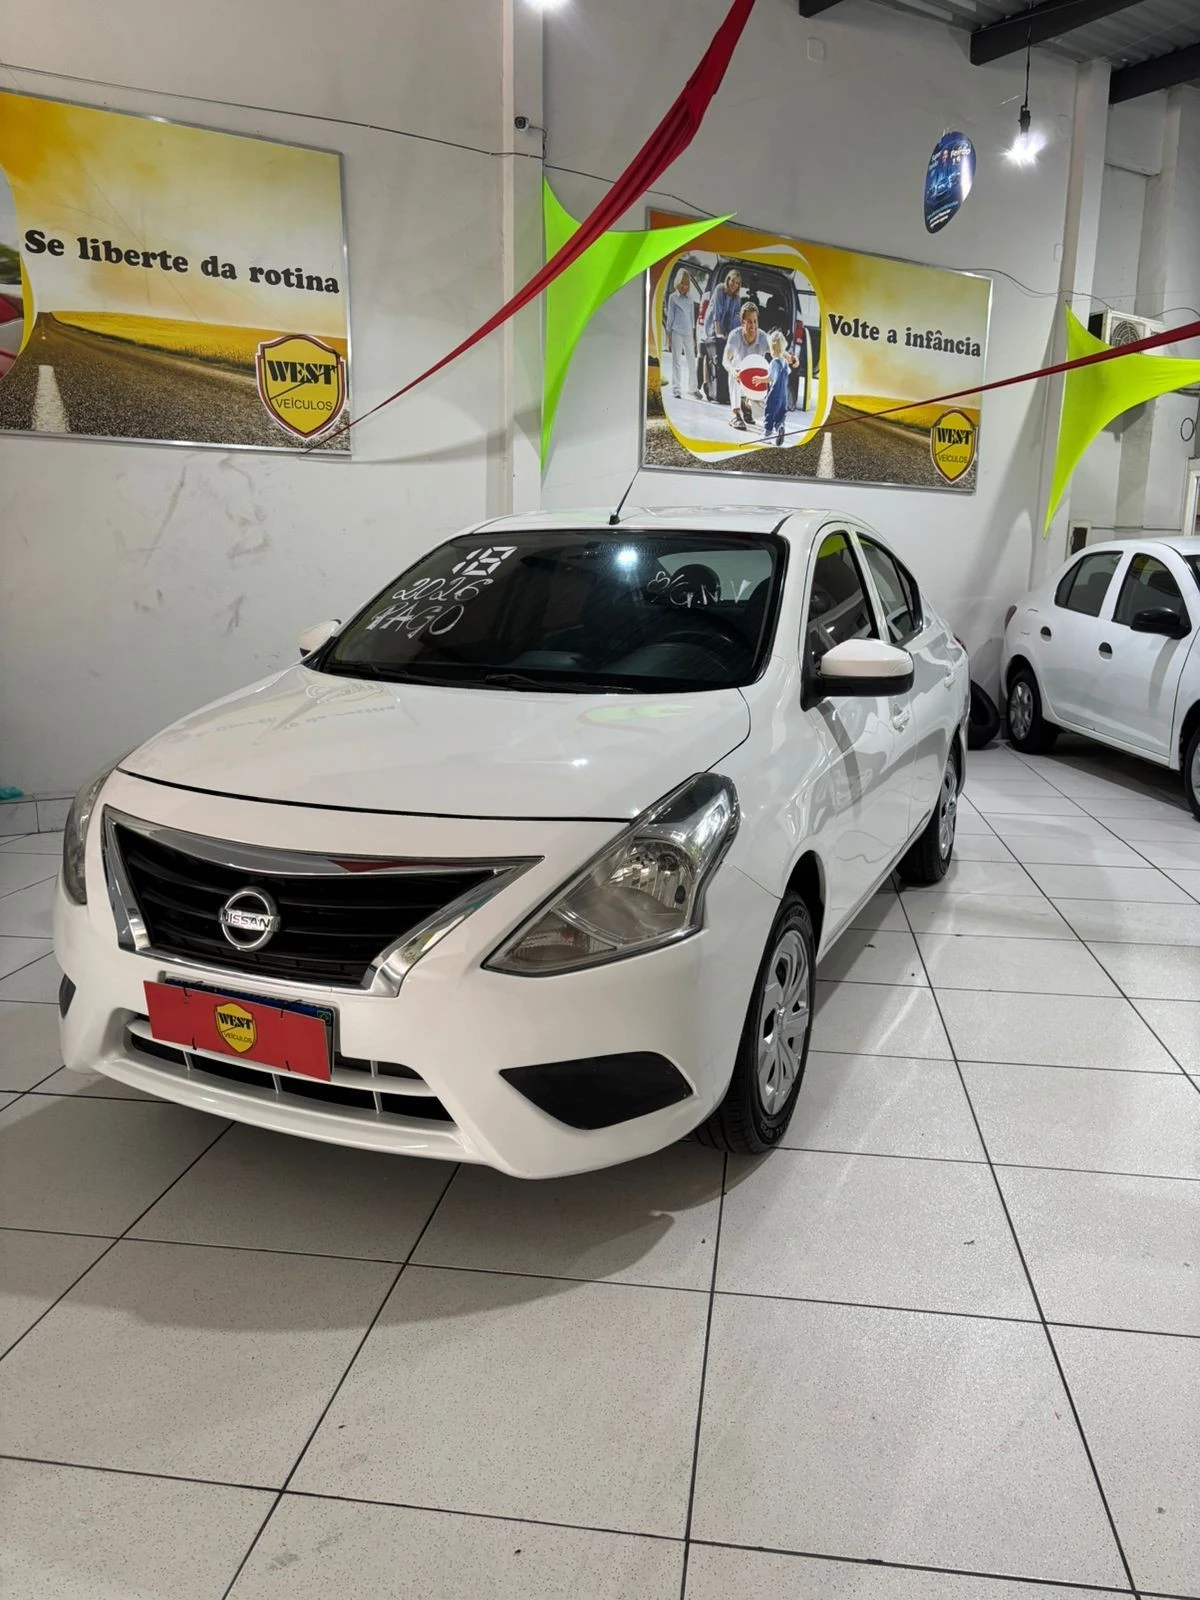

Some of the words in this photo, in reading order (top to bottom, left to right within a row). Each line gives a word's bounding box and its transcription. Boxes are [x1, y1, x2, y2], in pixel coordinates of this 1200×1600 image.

[25, 229, 65, 256] Se
[77, 237, 189, 273] liberte
[200, 255, 238, 280] da
[249, 266, 340, 294] rotina
[828, 313, 880, 341] Volte
[886, 328, 898, 344] a
[904, 326, 981, 357] infância
[267, 360, 336, 385] WEST
[275, 397, 334, 411] VEÍCULOS
[937, 427, 973, 445] WEST
[451, 546, 518, 576] 18
[392, 576, 494, 602] 2026
[365, 601, 465, 639] PAGO
[221, 911, 271, 929] NISSAN
[217, 1011, 253, 1030] WEST
